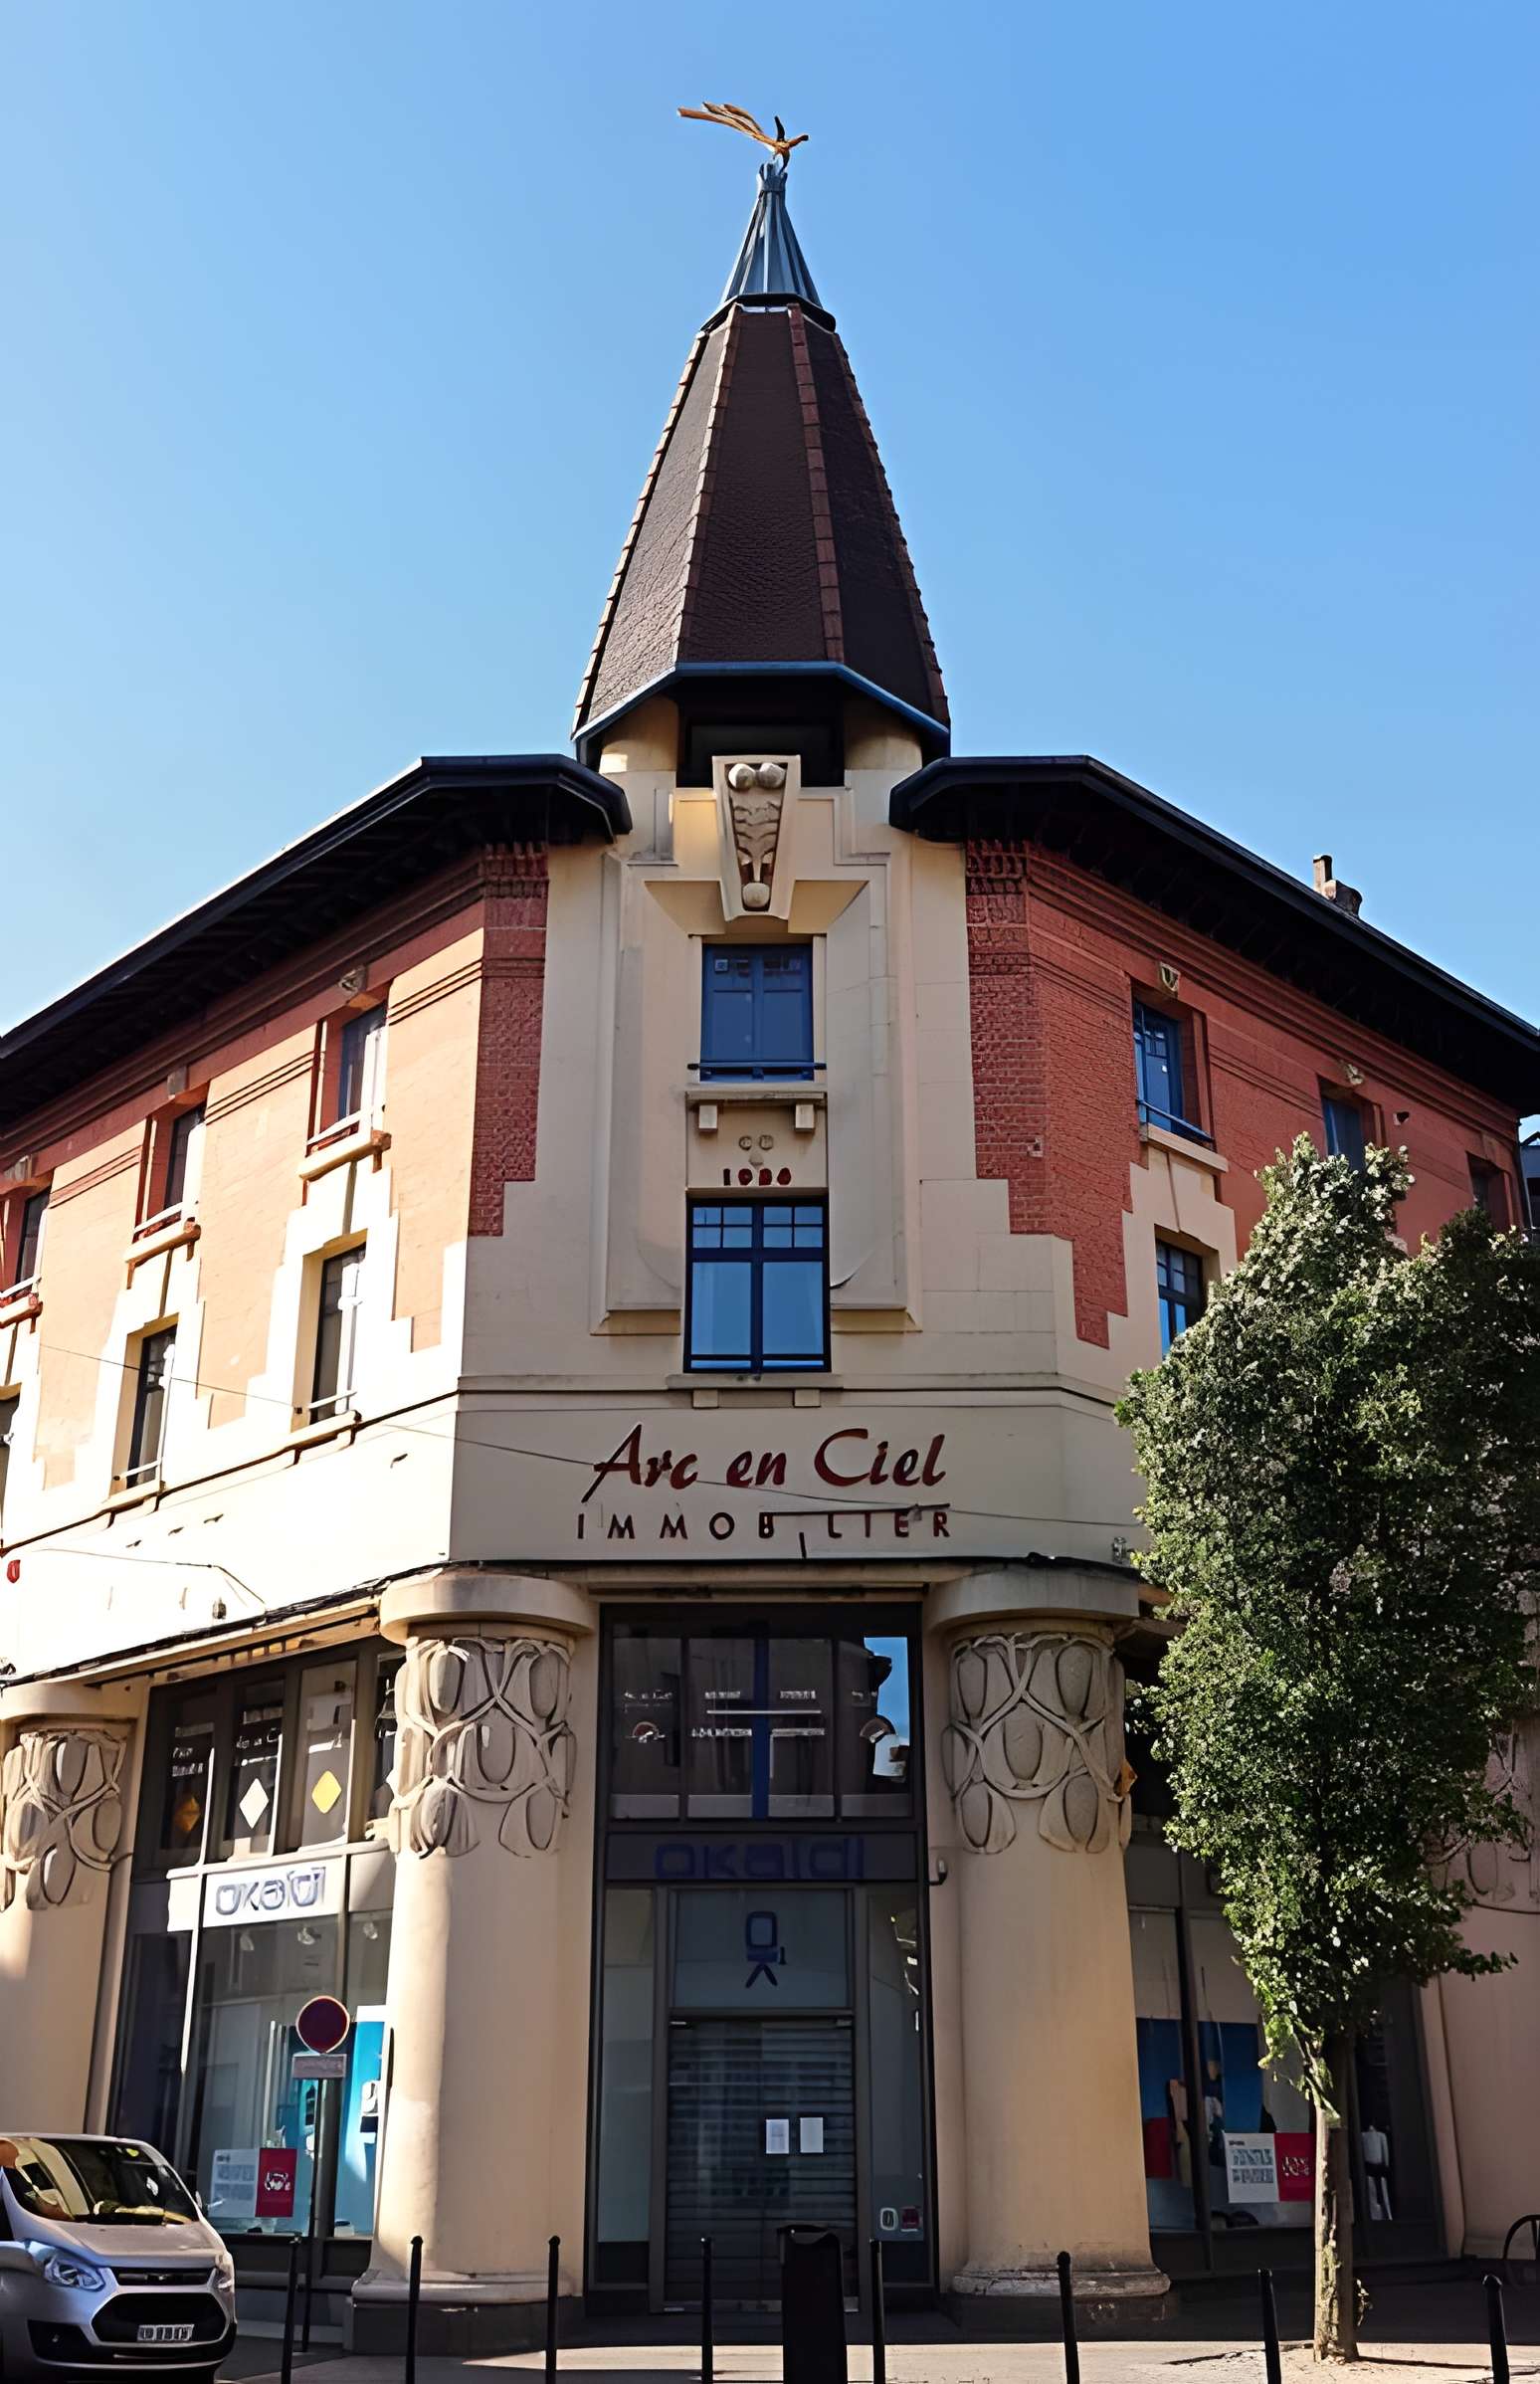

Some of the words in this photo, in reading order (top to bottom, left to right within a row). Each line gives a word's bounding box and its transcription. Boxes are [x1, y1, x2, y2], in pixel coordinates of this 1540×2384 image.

[723, 1167, 792, 1186] 19
[581, 1424, 698, 1503] Arc
[726, 1451, 787, 1488] en
[814, 1428, 946, 1487] Ciel
